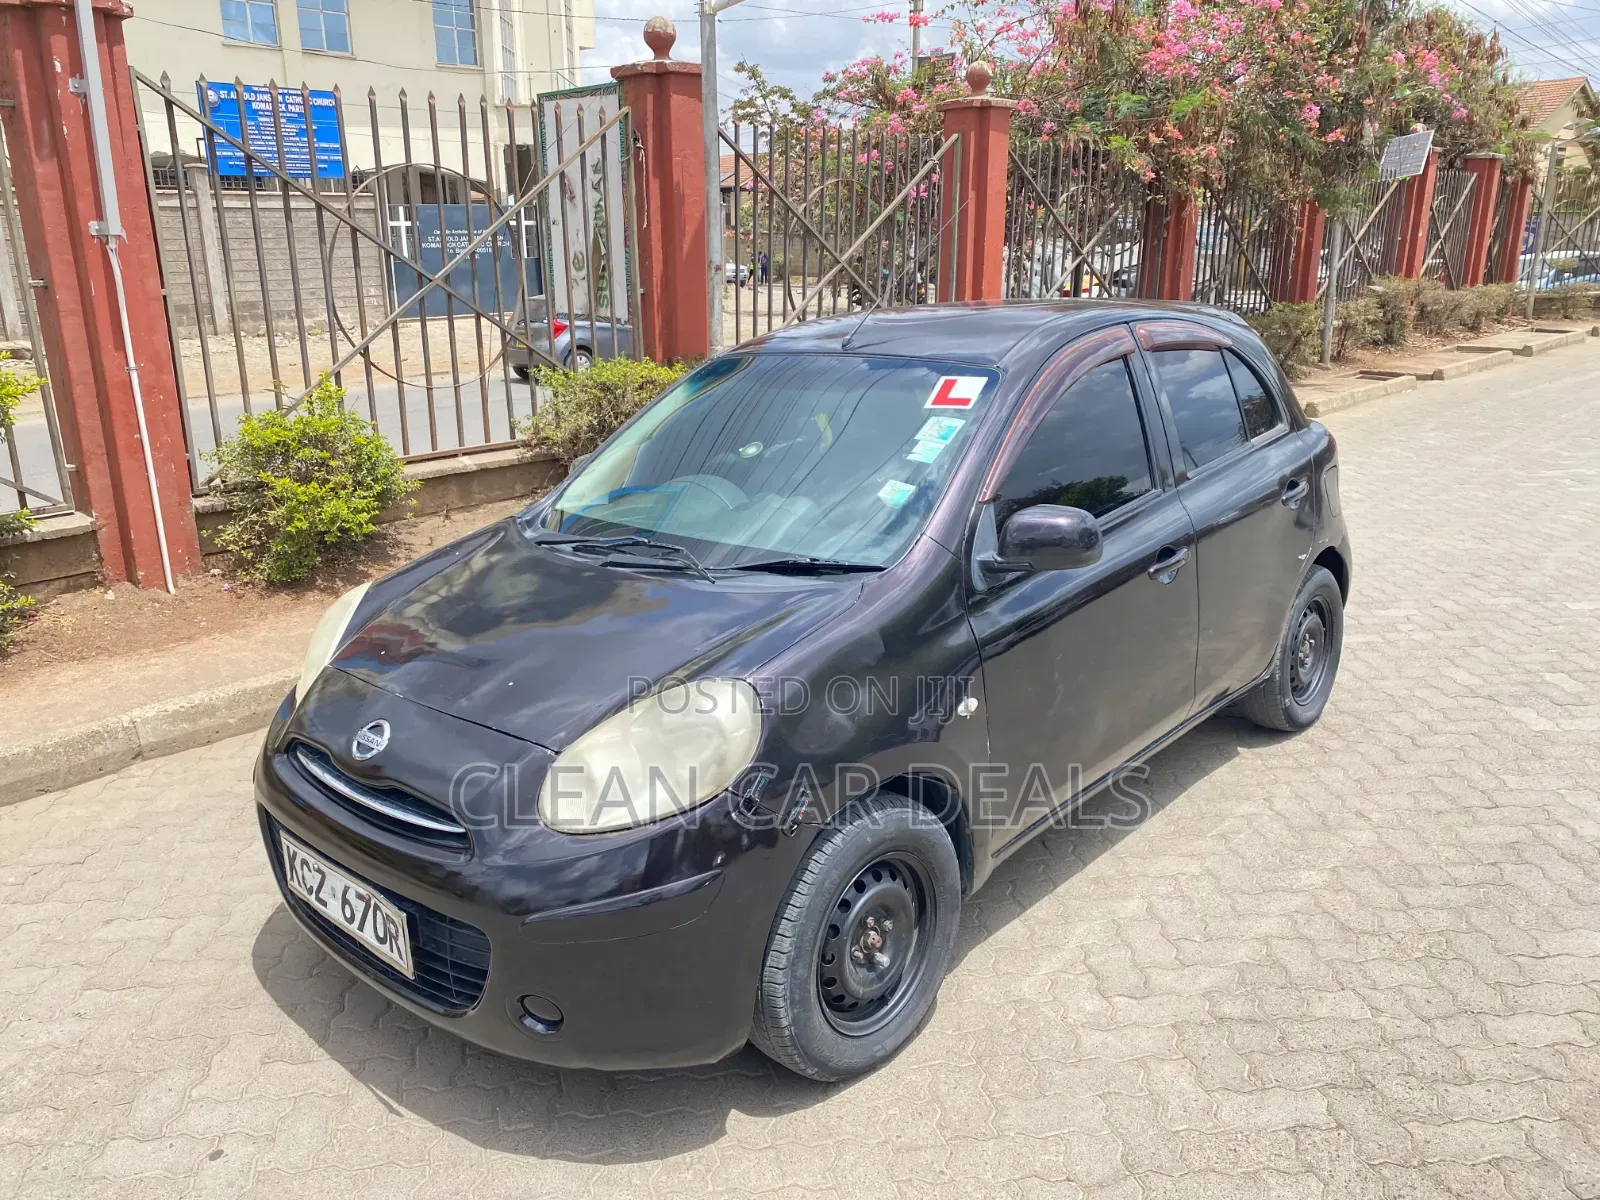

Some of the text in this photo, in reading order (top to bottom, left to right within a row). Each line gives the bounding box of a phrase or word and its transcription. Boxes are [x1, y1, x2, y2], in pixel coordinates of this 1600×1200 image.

[219, 90, 229, 99] ST.
[230, 91, 255, 101] AOLD
[256, 93, 282, 103] JANSN
[930, 379, 973, 407] L
[286, 845, 406, 967] KCZ 670R
